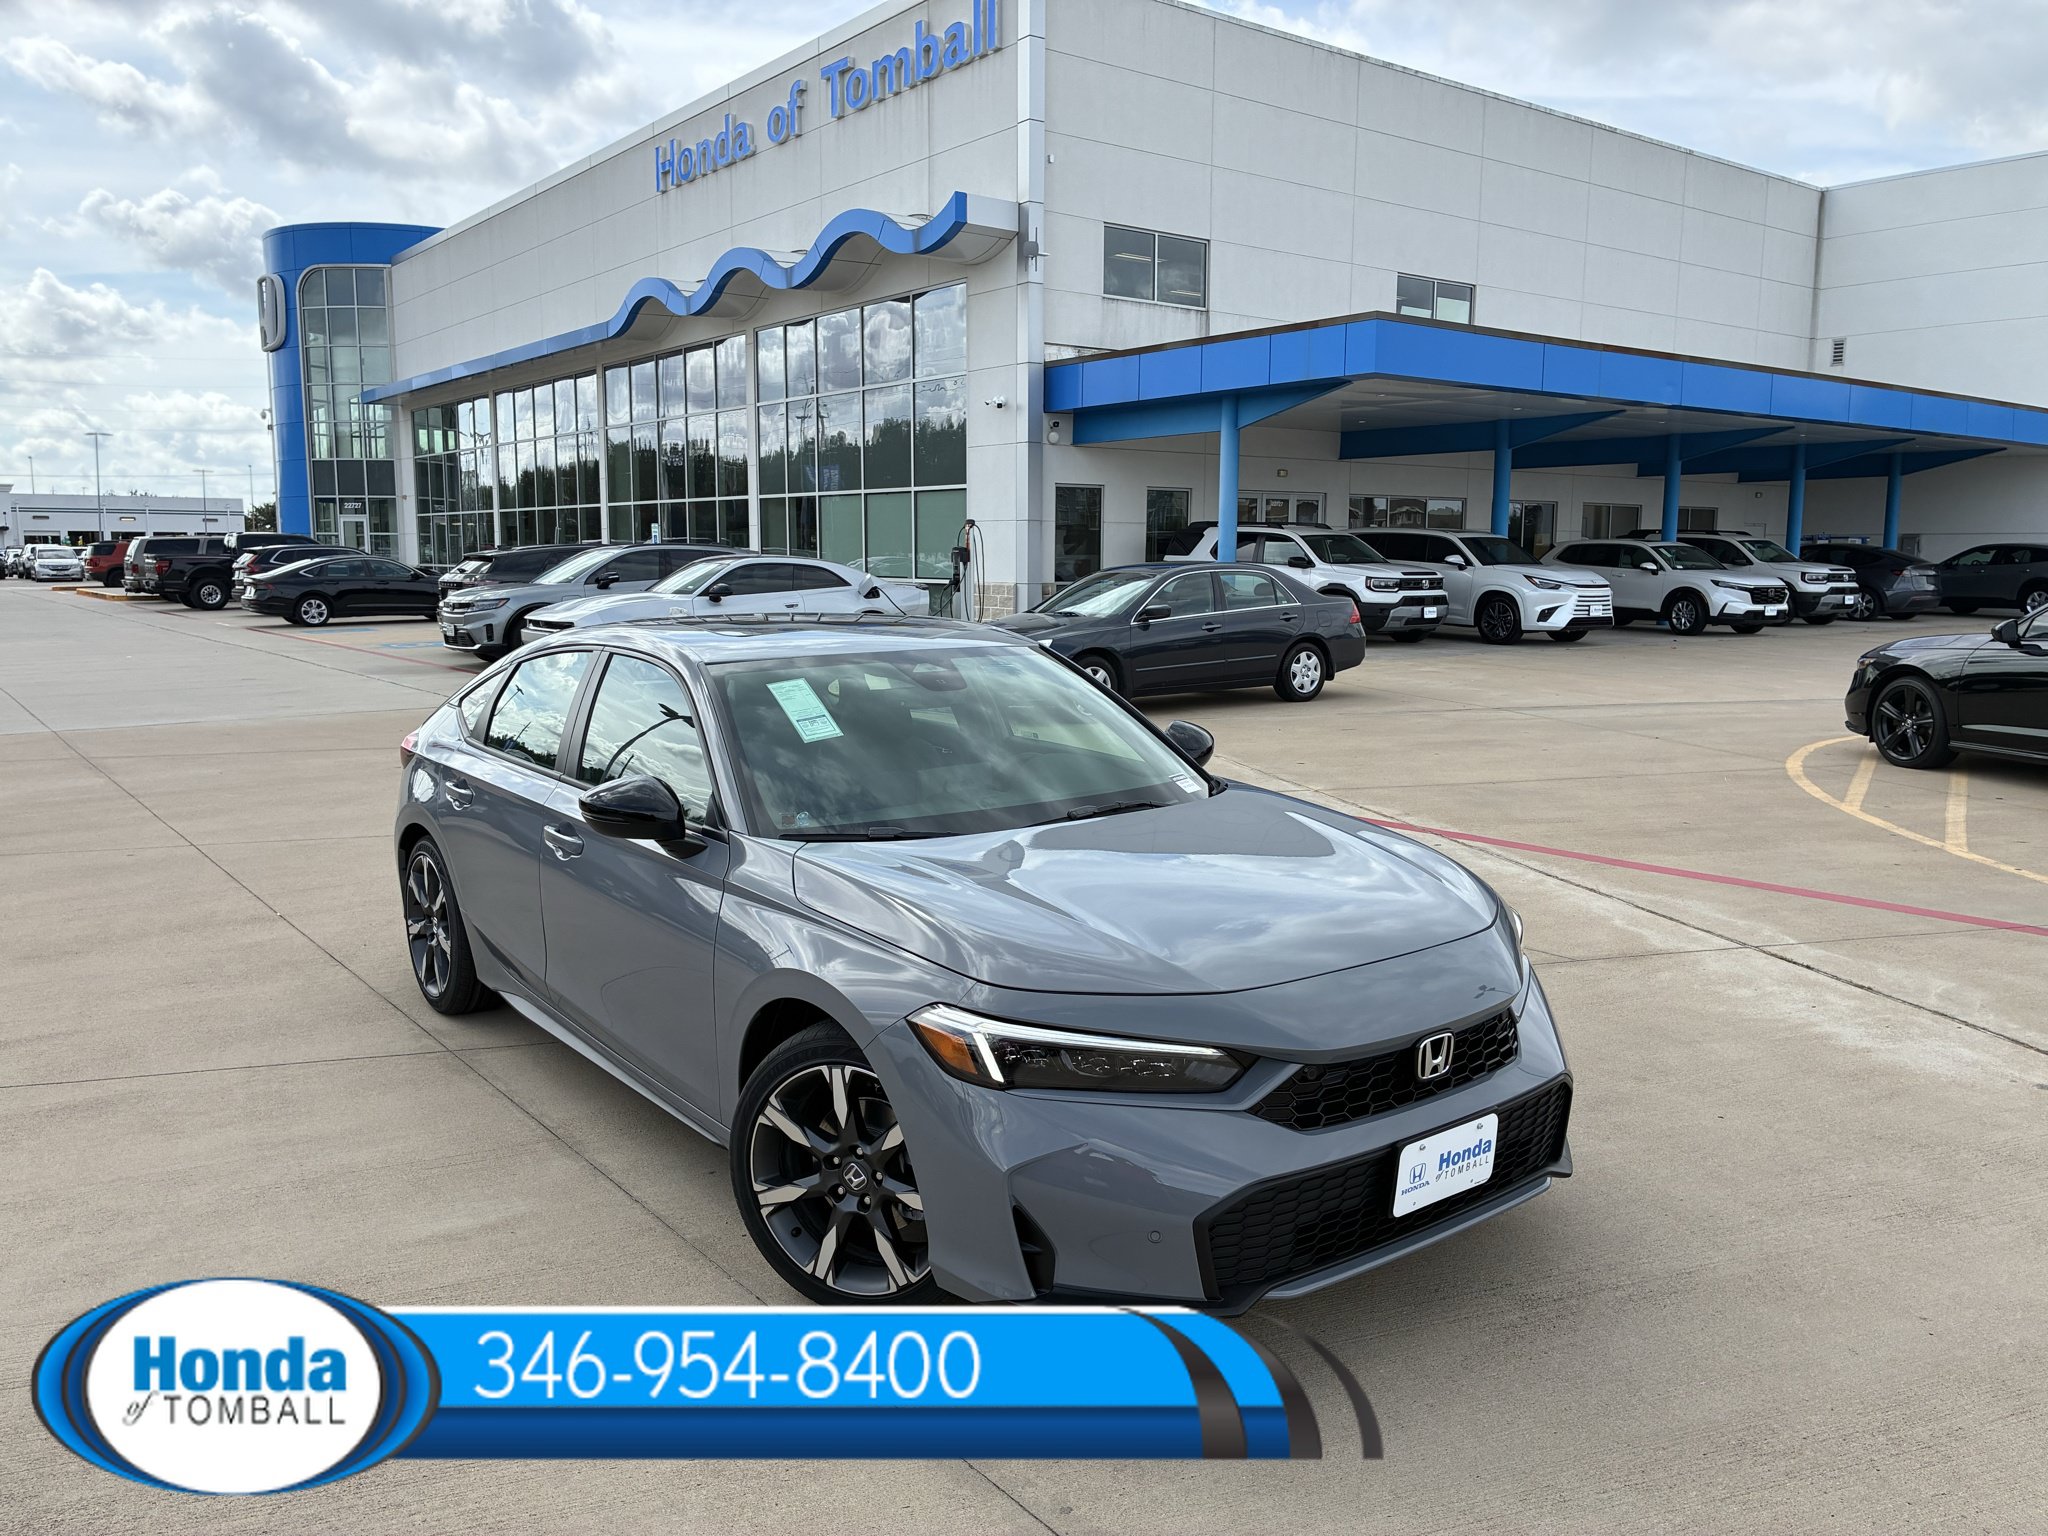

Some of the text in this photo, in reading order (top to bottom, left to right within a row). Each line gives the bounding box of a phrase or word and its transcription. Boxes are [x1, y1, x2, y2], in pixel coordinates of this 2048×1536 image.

[655, 0, 1002, 192] Honda of Tomball
[1438, 1139, 1492, 1171] Honda
[1445, 1155, 1489, 1179] TOMBALL
[1401, 1181, 1430, 1196] HONDA
